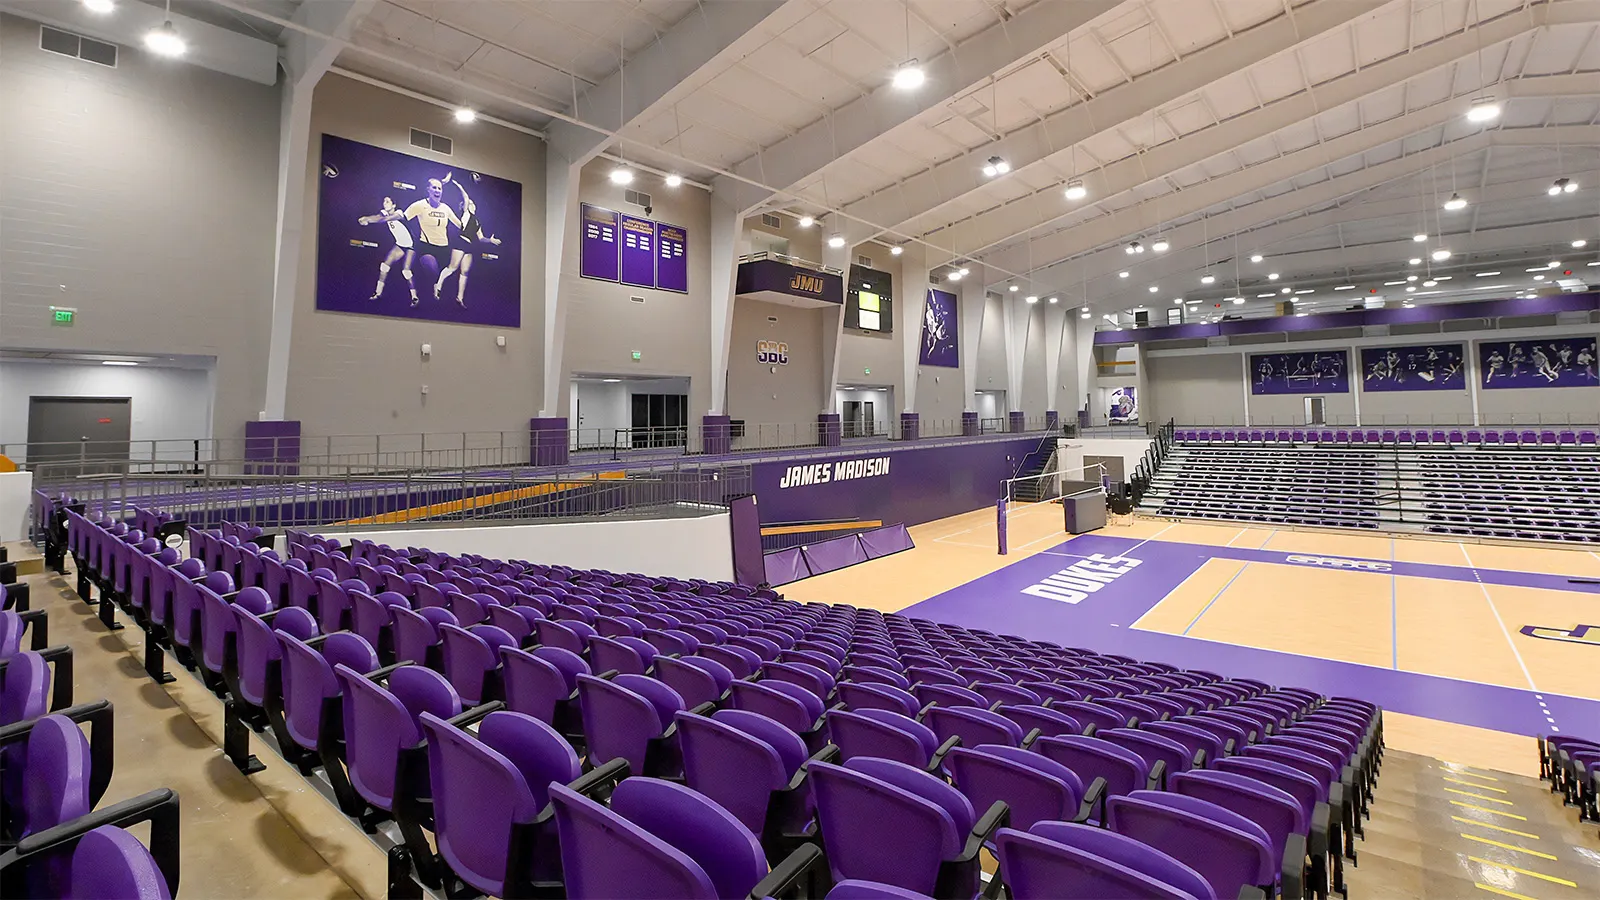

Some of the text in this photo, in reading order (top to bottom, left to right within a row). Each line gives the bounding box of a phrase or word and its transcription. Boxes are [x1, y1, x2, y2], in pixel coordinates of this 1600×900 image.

[791, 273, 824, 294] JMU
[55, 311, 72, 322] EXIT
[780, 457, 891, 489] JAMES MADISON
[1020, 553, 1143, 605] DUKES
